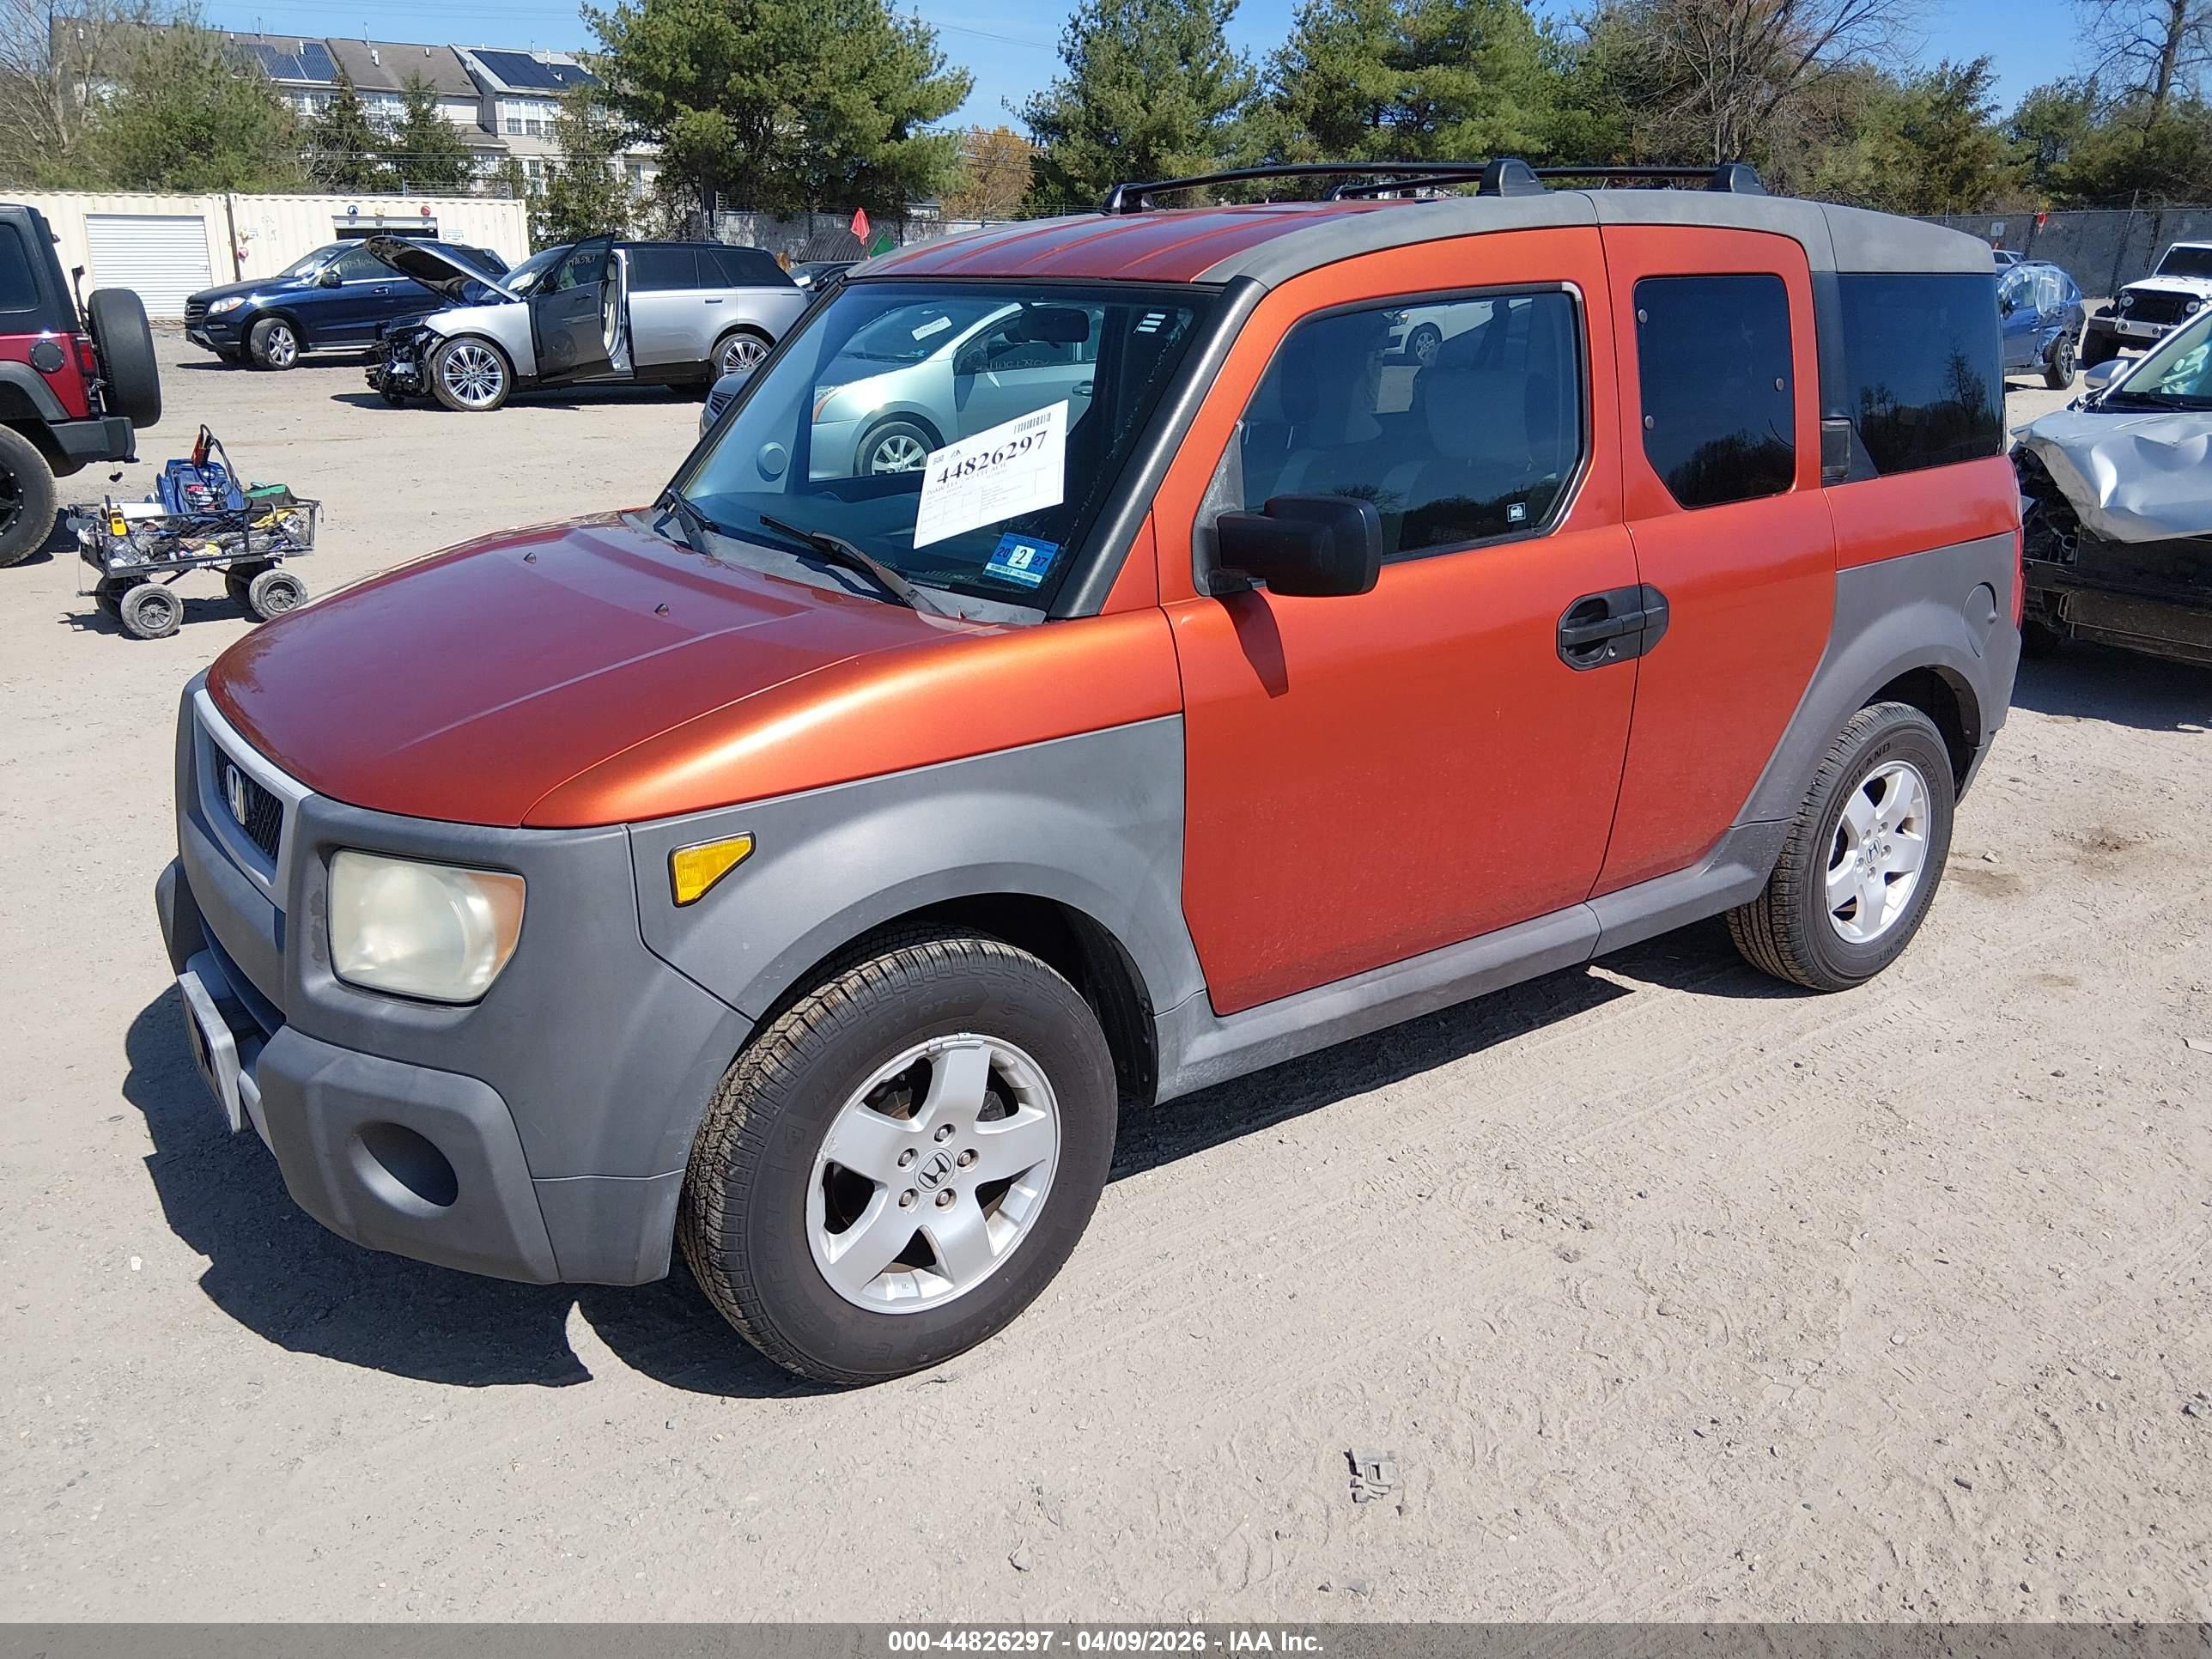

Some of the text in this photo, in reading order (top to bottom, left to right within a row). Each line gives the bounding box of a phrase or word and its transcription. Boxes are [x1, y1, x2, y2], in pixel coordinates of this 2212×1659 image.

[937, 429, 1048, 483] 44826297
[996, 546, 1048, 567] 20 2 27
